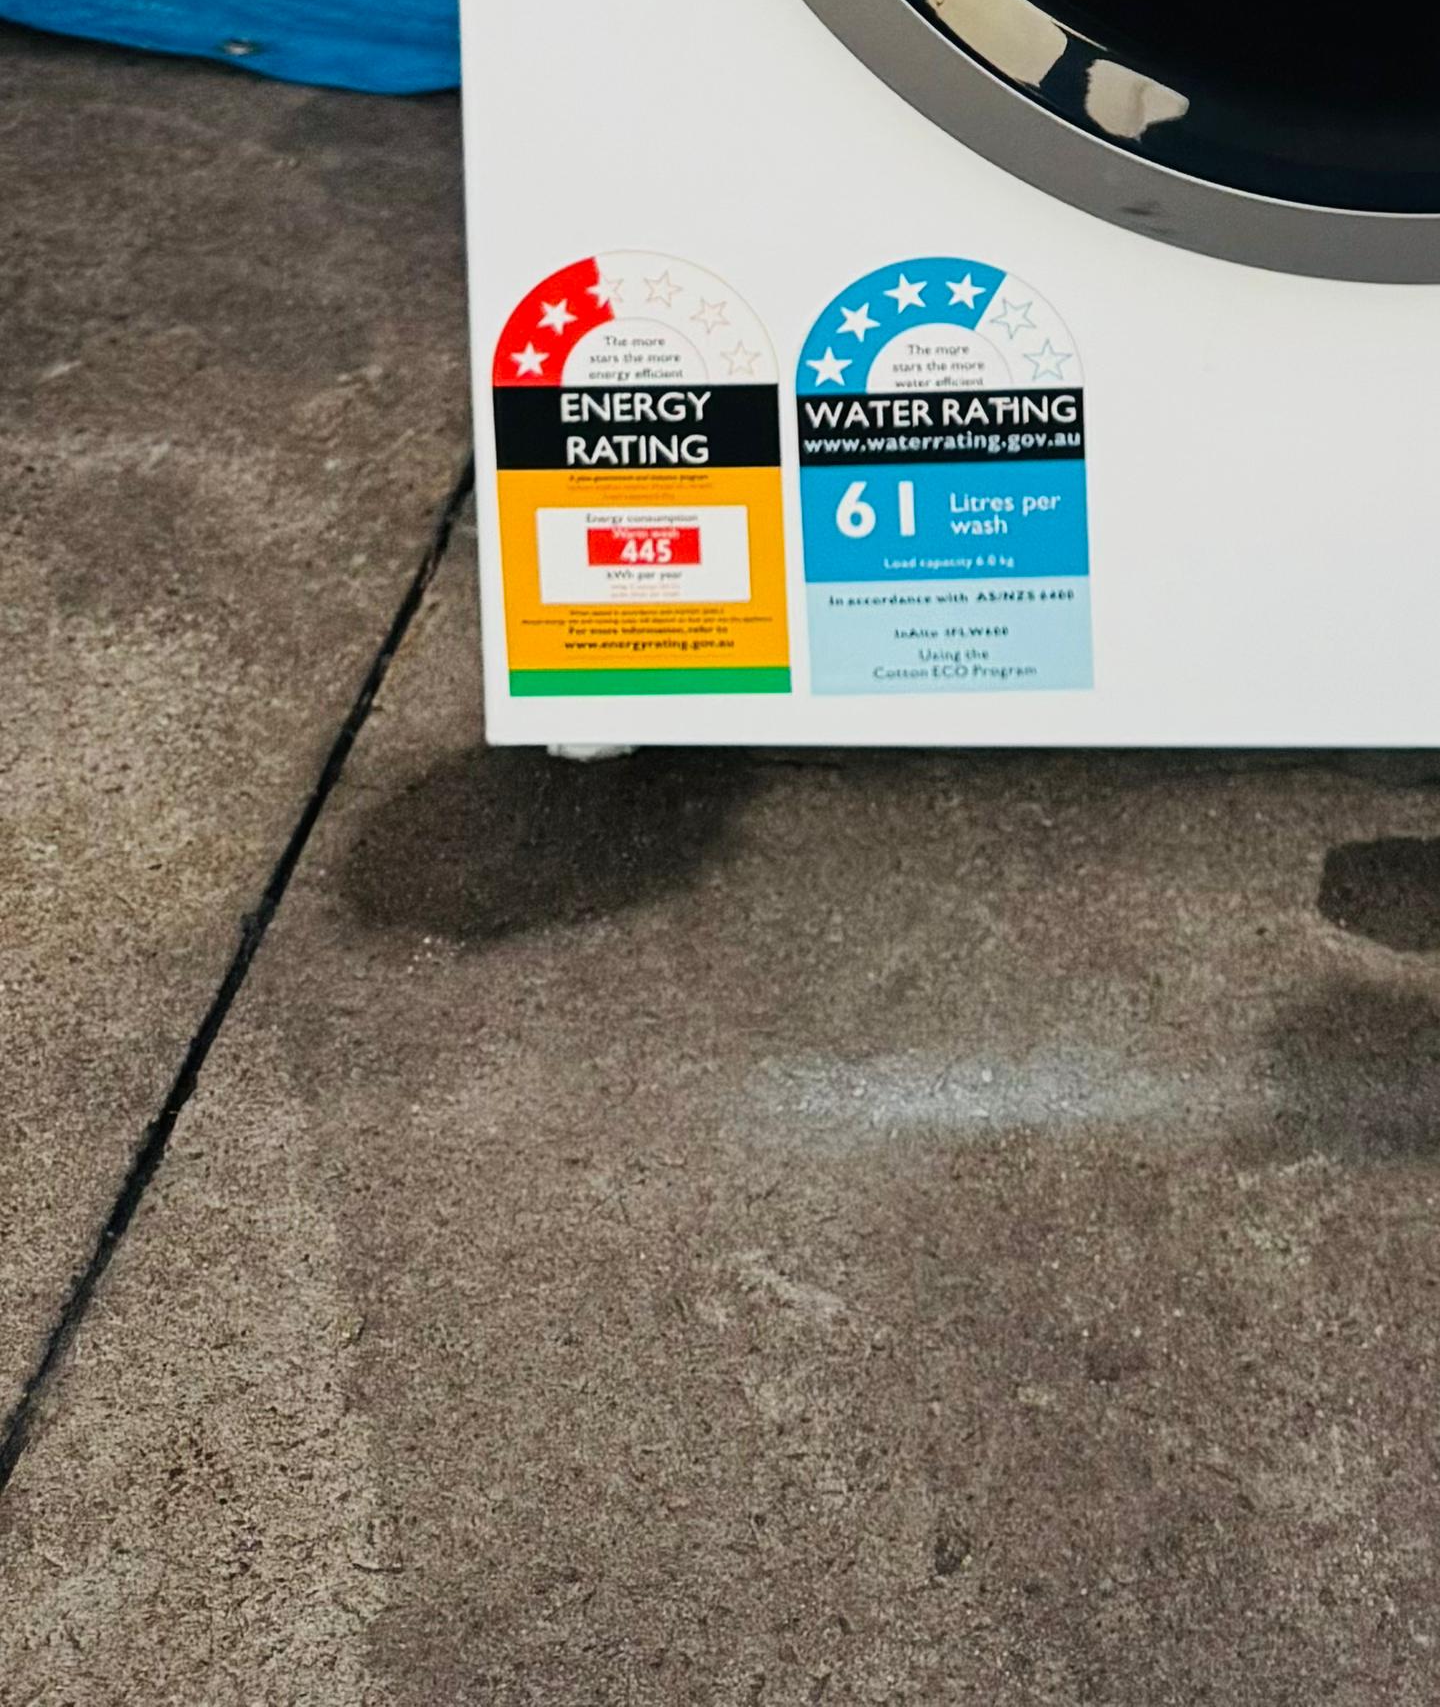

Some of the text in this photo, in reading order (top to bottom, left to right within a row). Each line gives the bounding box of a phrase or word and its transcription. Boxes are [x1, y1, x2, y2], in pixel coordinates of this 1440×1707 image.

[605, 336, 666, 347] The more
[907, 344, 969, 356] The more
[590, 353, 682, 364] stars the more
[589, 368, 684, 382] energy efficient
[892, 361, 985, 373] stars the more
[895, 377, 984, 388] water efficient
[560, 390, 712, 424] ENERGY
[804, 394, 1078, 429] WATER RATING
[566, 434, 710, 467] RATING
[804, 431, 1081, 454] www.waterrating.gov.au
[950, 492, 1062, 516] Litres per
[950, 515, 1008, 535] wash
[620, 538, 673, 564] 445
[883, 557, 917, 570] Load
[919, 558, 973, 570] capacity
[999, 555, 1015, 569] kg
[828, 595, 844, 607] In
[847, 594, 932, 606] accordance
[935, 592, 968, 604] with
[975, 590, 1036, 602] AS/NZS
[564, 638, 735, 652] www.energyrating.gov.au
[918, 648, 989, 663] Using the
[872, 663, 1038, 681] Cotton ECO Program
